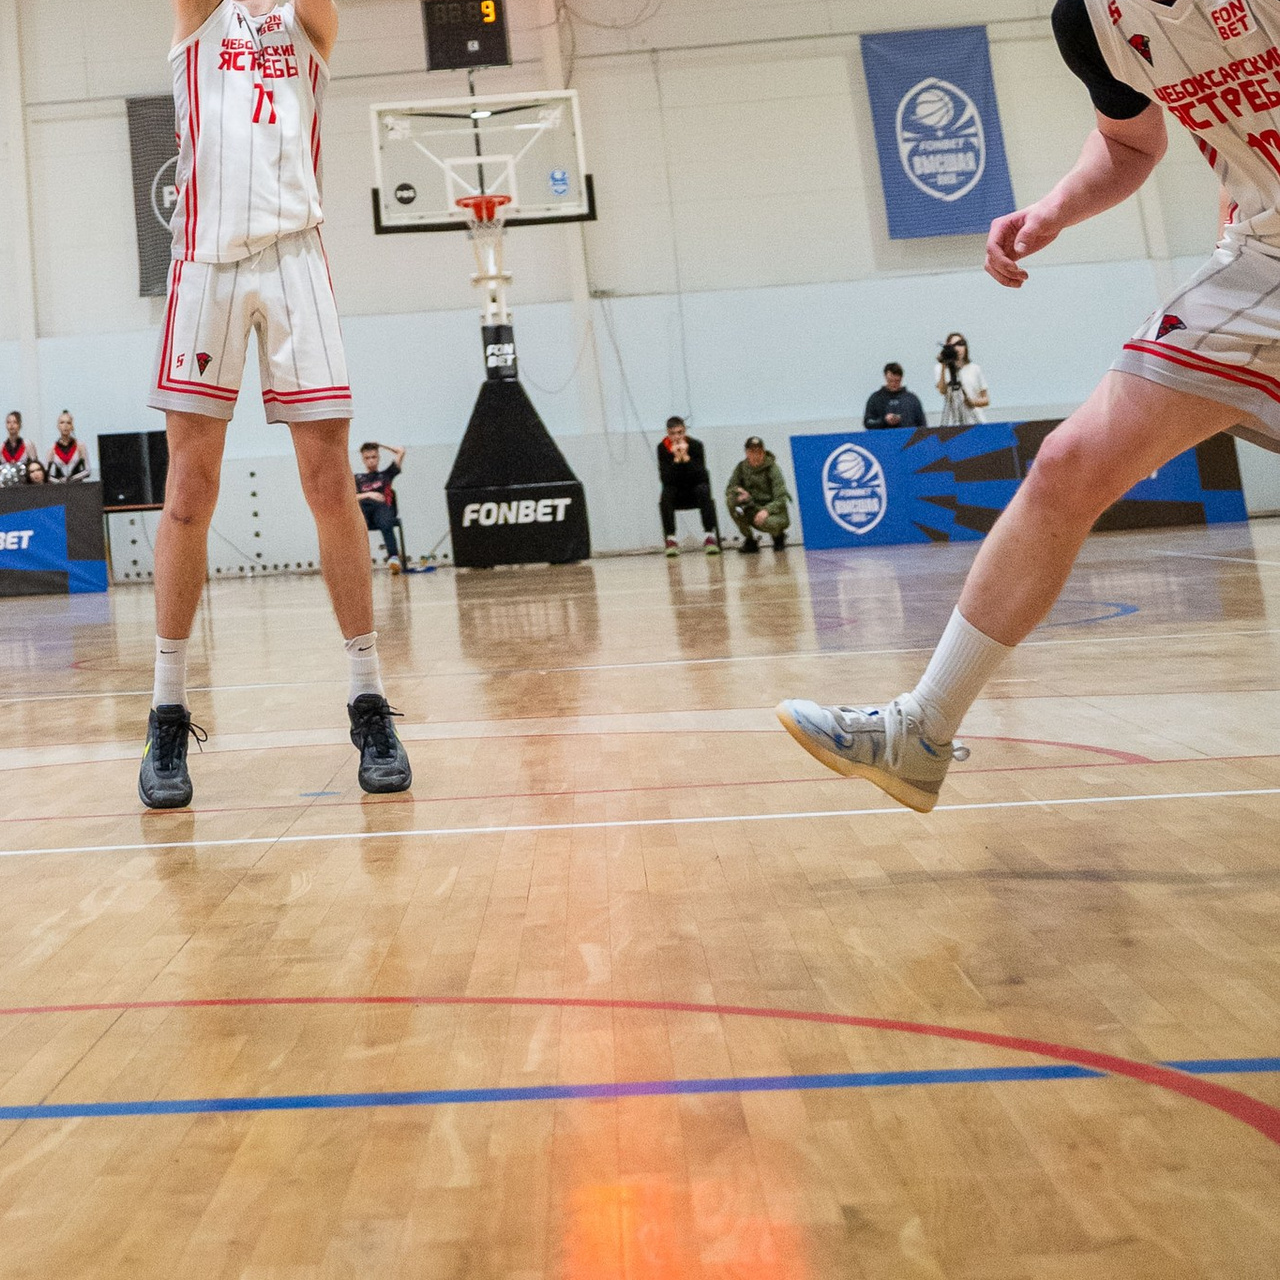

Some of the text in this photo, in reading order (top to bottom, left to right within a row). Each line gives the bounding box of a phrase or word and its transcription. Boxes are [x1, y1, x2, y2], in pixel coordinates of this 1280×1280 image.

[265, 14, 282, 25] ON
[481, 0, 496, 23] 9
[1218, 13, 1249, 41] BET
[1167, 71, 1280, 131] ЯСТРЕБ
[462, 497, 572, 527] FONBET
